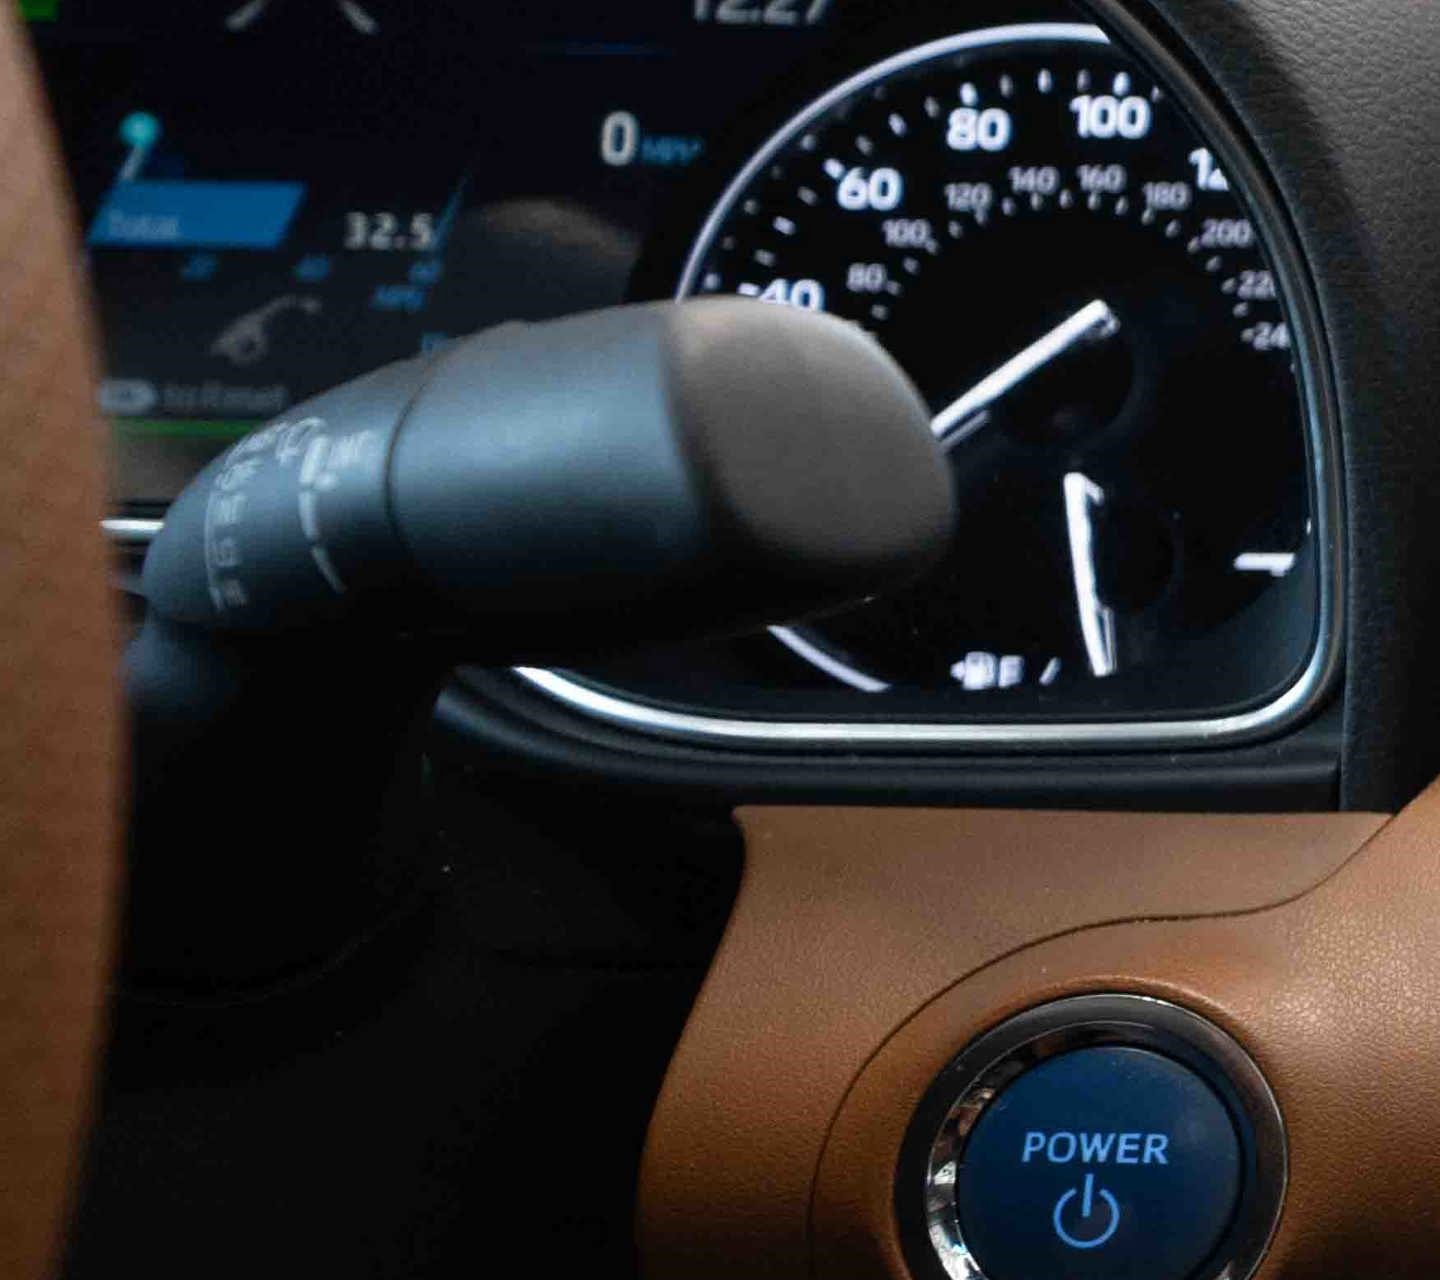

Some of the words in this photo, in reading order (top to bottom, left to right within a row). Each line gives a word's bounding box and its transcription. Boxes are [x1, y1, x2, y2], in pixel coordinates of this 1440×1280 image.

[601, 110, 638, 166] 0
[947, 107, 1011, 151] 80
[1069, 95, 1150, 138] 100
[837, 167, 902, 211] 60
[1022, 1131, 1169, 1164] POWER
